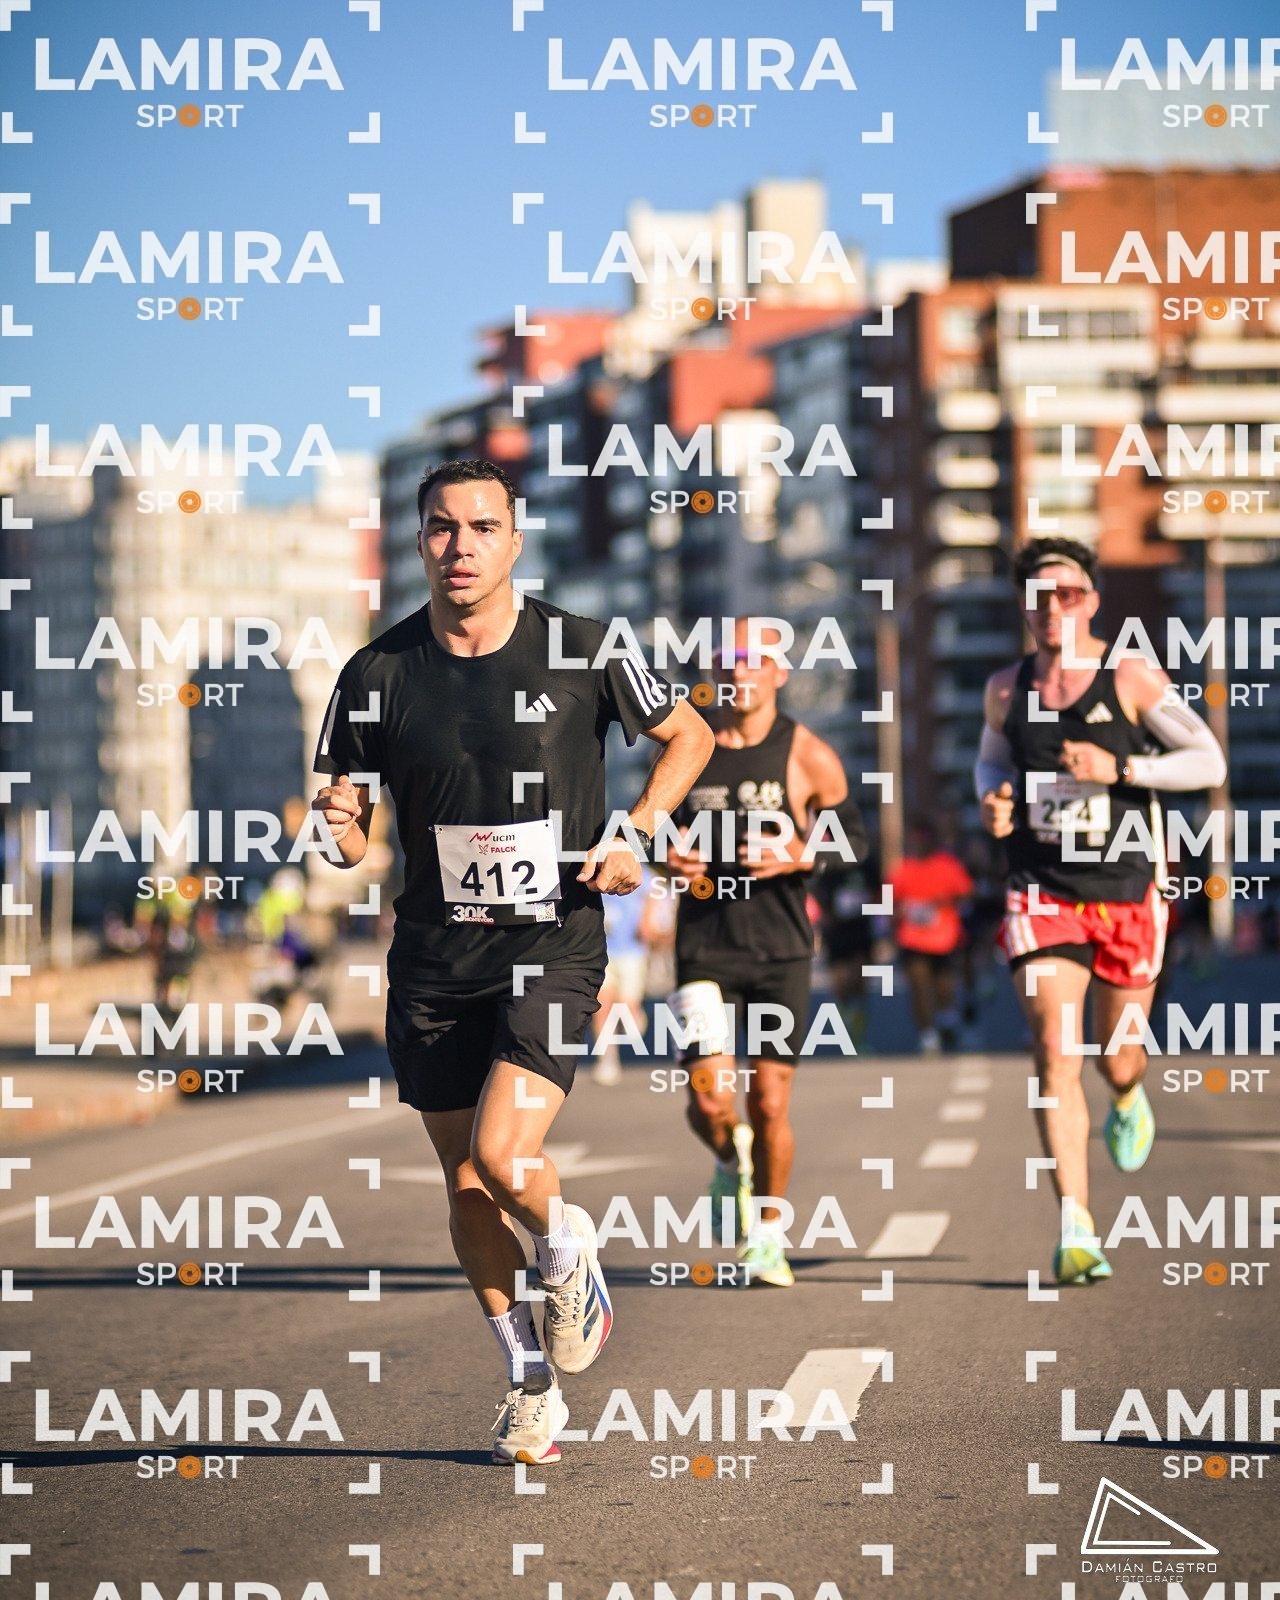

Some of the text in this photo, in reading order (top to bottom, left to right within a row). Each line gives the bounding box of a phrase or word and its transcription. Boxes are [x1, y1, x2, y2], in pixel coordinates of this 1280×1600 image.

[492, 834, 515, 842] ucm
[490, 845, 516, 854] FALCK
[460, 860, 538, 897] 412
[452, 905, 489, 922] 30K
